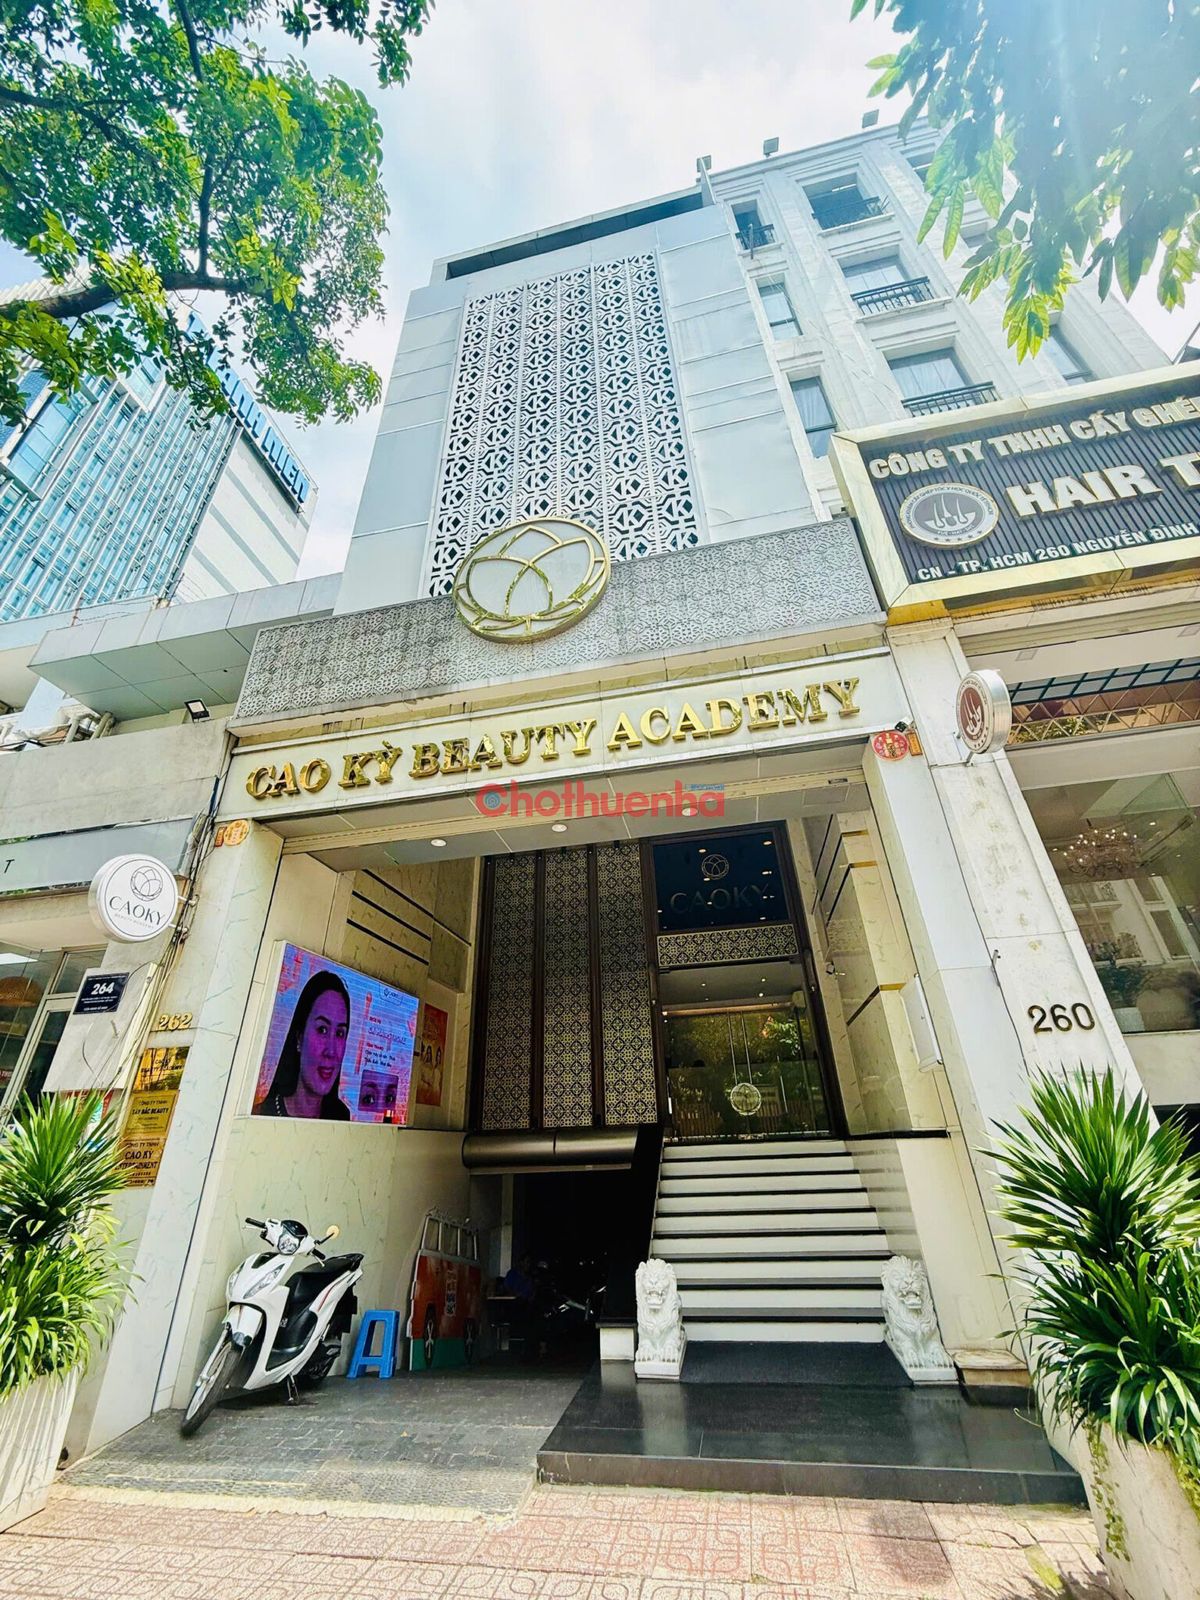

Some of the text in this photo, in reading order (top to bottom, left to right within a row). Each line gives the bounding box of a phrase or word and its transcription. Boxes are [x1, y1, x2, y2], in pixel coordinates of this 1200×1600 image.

[868, 448, 949, 479] CÔNG
[947, 440, 985, 464] TY
[987, 424, 1072, 457] TNHH
[1070, 409, 1132, 440] CẤY
[1005, 451, 1200, 519] HAIR T
[917, 566, 943, 581] CN
[958, 560, 987, 573] TP.
[991, 551, 1032, 568] HCM
[1035, 544, 1069, 561] 260
[1076, 528, 1147, 554] NGUYỄN
[1151, 521, 1199, 540] ĐÌNH
[245, 757, 333, 801] CAO
[338, 740, 403, 789] KỲ
[408, 716, 598, 780] BEAUTY
[606, 677, 862, 751] ACADEMY
[109, 895, 166, 926] CAOKY
[670, 882, 770, 914] CAOKY
[90, 981, 115, 995] 264
[158, 1012, 193, 1032] 262
[1027, 1002, 1096, 1035] 260
[125, 1150, 142, 1160] CAO
